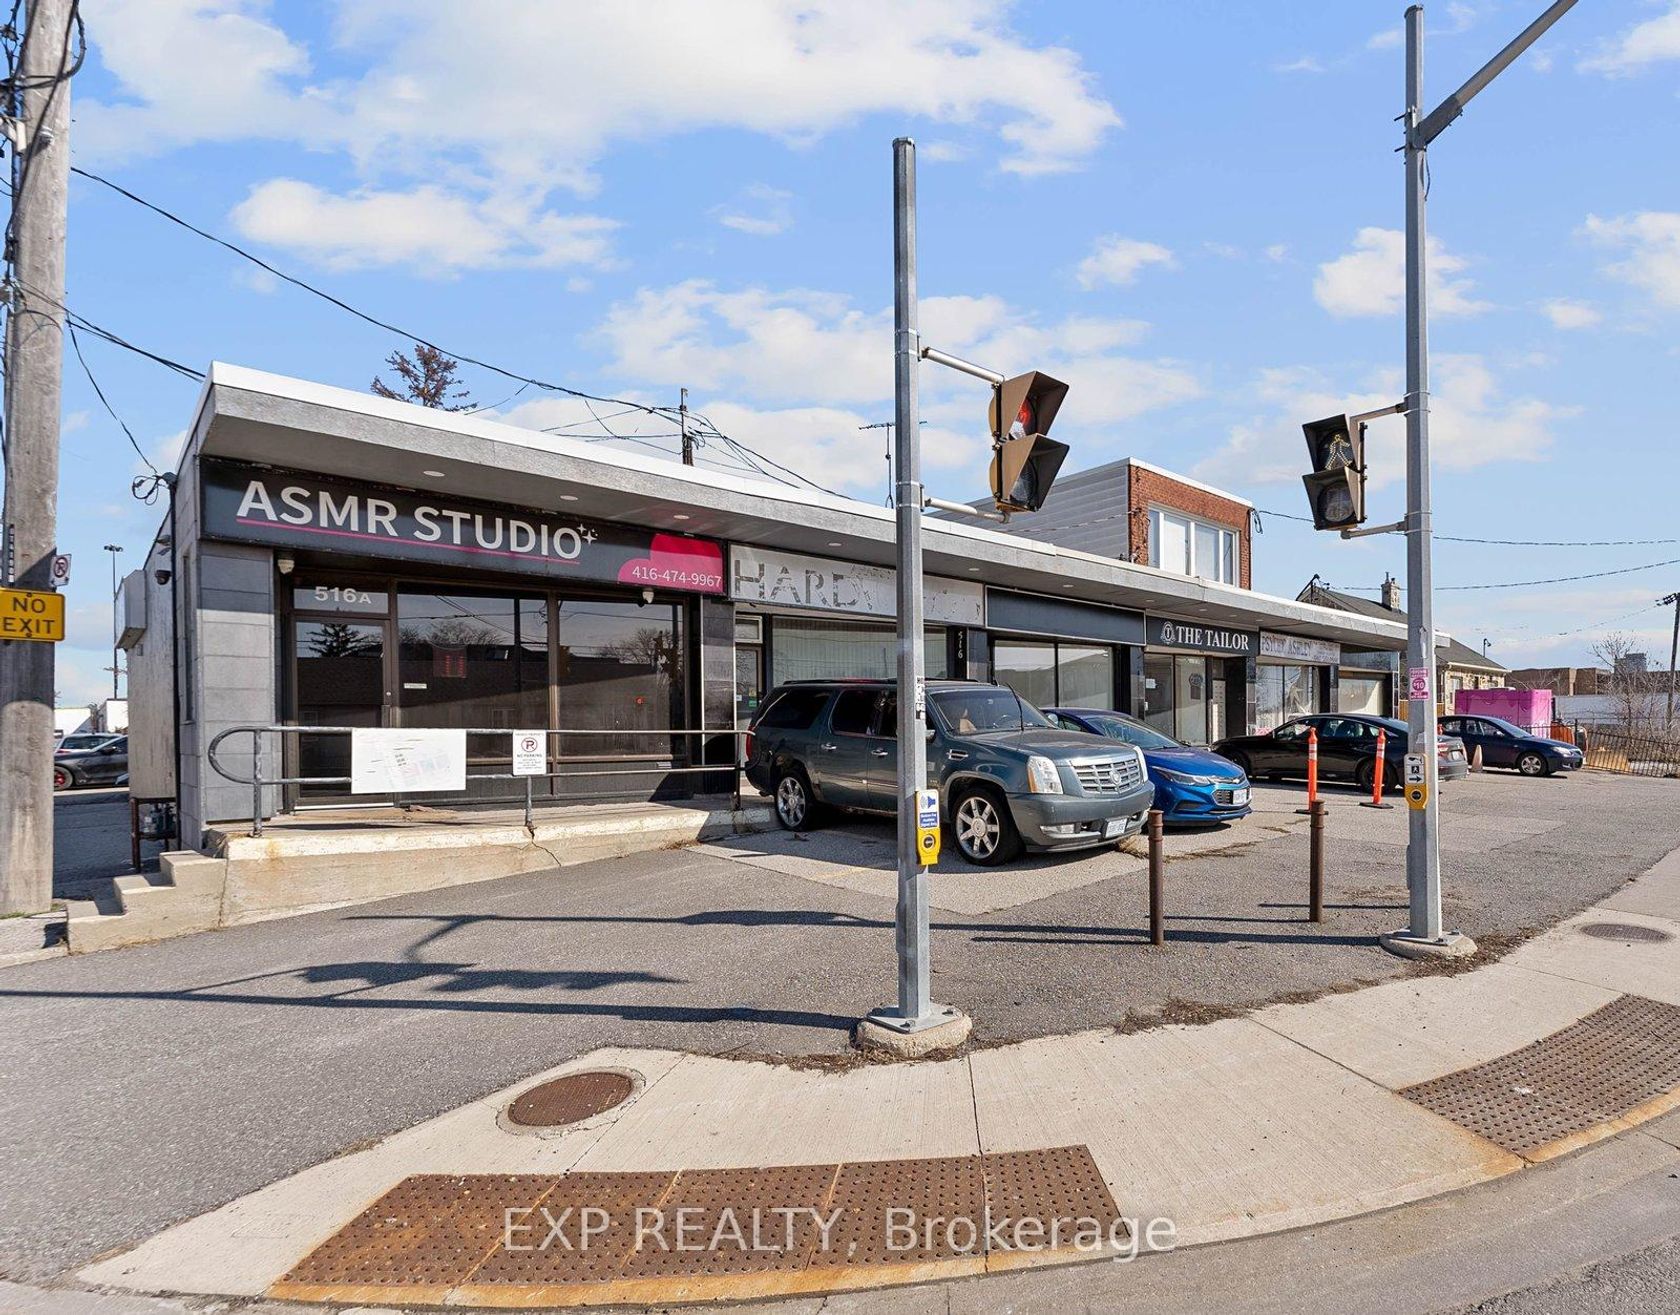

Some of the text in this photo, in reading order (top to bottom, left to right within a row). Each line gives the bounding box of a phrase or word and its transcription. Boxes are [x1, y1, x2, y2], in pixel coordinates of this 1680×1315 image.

[236, 480, 583, 560] ASMR STUDIO
[632, 565, 722, 588] 416-474-9967
[13, 596, 46, 614] NO
[313, 586, 372, 605] 516A
[3, 616, 55, 634] EXIT
[1175, 625, 1250, 651] THE TAILOR
